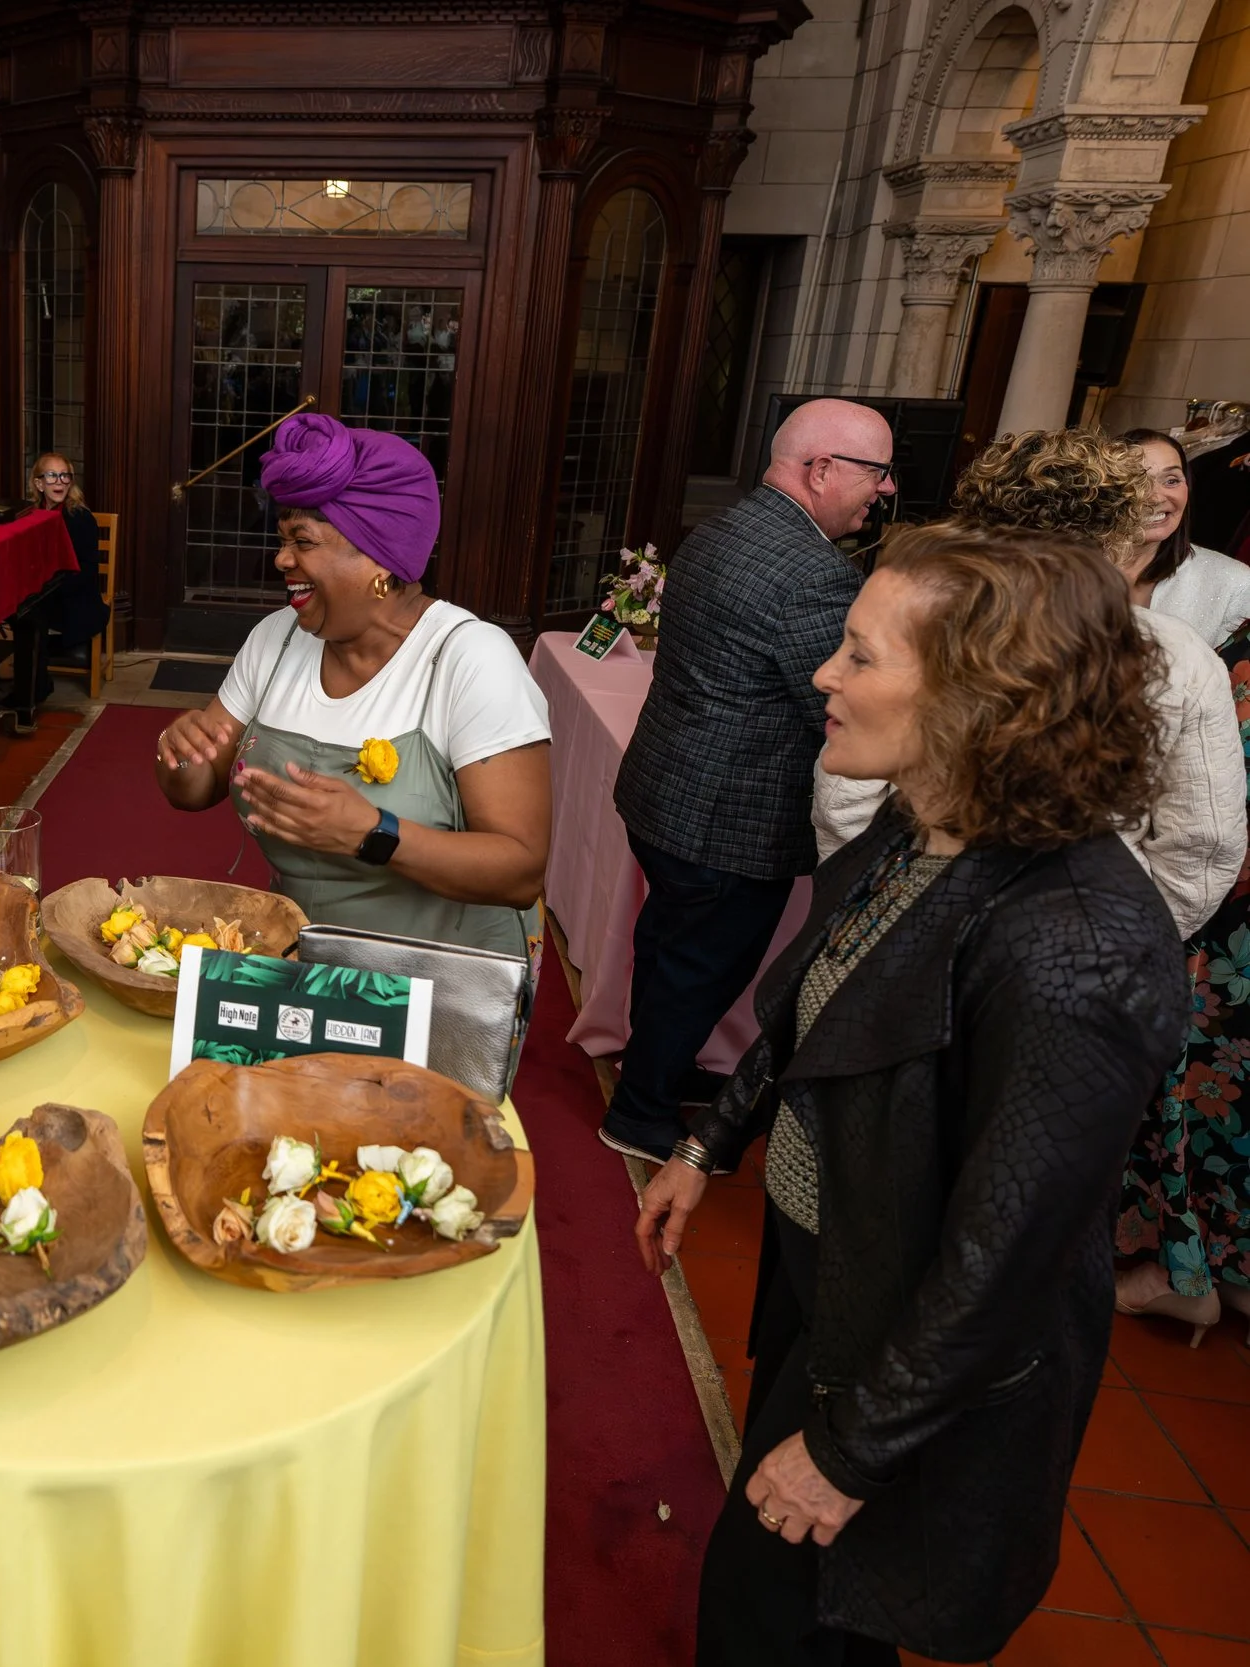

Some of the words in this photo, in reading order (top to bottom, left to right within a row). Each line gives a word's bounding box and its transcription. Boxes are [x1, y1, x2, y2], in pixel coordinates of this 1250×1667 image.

[220, 1005, 238, 1024] High
[239, 1009, 257, 1023] Note
[361, 1027, 379, 1043] LANE
